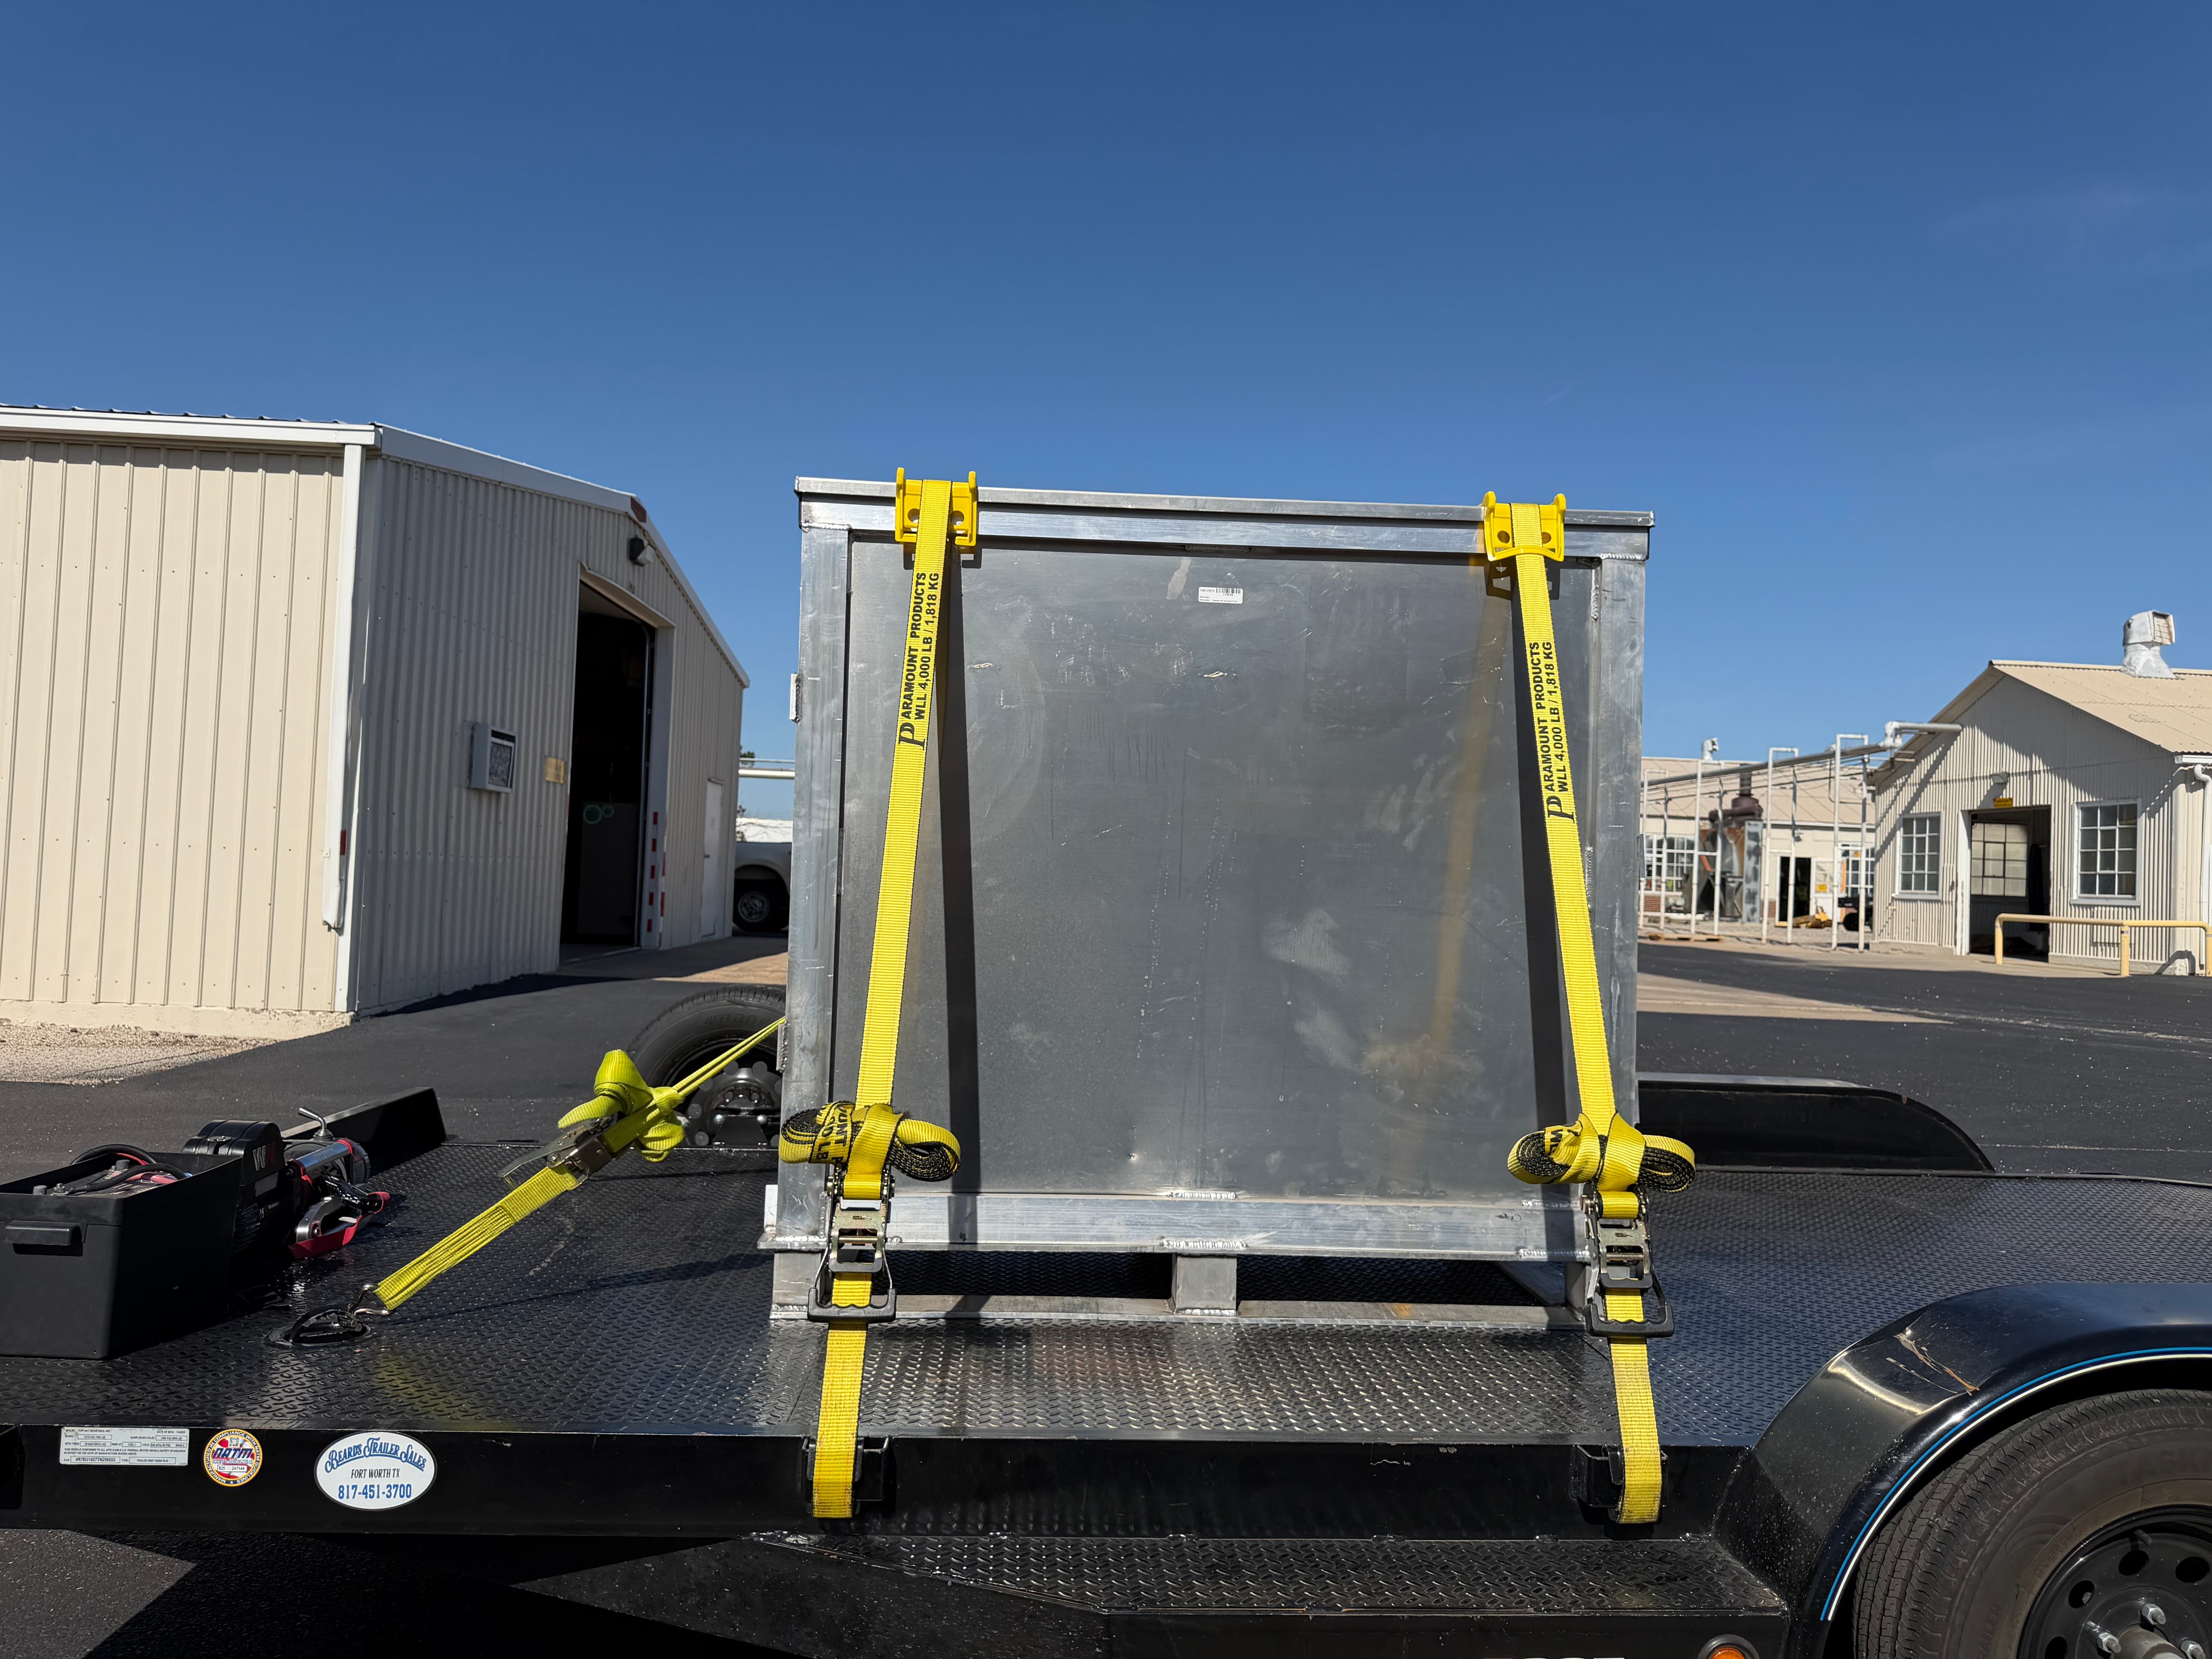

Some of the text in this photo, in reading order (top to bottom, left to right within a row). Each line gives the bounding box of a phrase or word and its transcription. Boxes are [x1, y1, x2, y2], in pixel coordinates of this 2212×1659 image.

[928, 573, 939, 590] KG
[910, 573, 926, 638] PRODUCTS
[925, 593, 937, 626] 1,818
[922, 637, 933, 652] LB
[1542, 642, 1552, 660] KG
[919, 656, 931, 690] 4,000
[1529, 642, 1546, 710] PRODUCTS
[1545, 663, 1559, 696] 1,818
[914, 692, 926, 720] WLL
[1550, 707, 1560, 724] LB
[1552, 729, 1567, 762] 4,000
[1556, 765, 1569, 793] WLL
[816, 1141, 831, 1159] LB
[213, 1431, 245, 1442] COMPLIANCE
[246, 1434, 257, 1445] WITH
[363, 1437, 400, 1457] TRAILER
[400, 1444, 427, 1470] SALES
[237, 1461, 259, 1483] GUIDELINES
[351, 1468, 400, 1479] FORT WORTH TX
[338, 1484, 412, 1499] 817-451-3700
